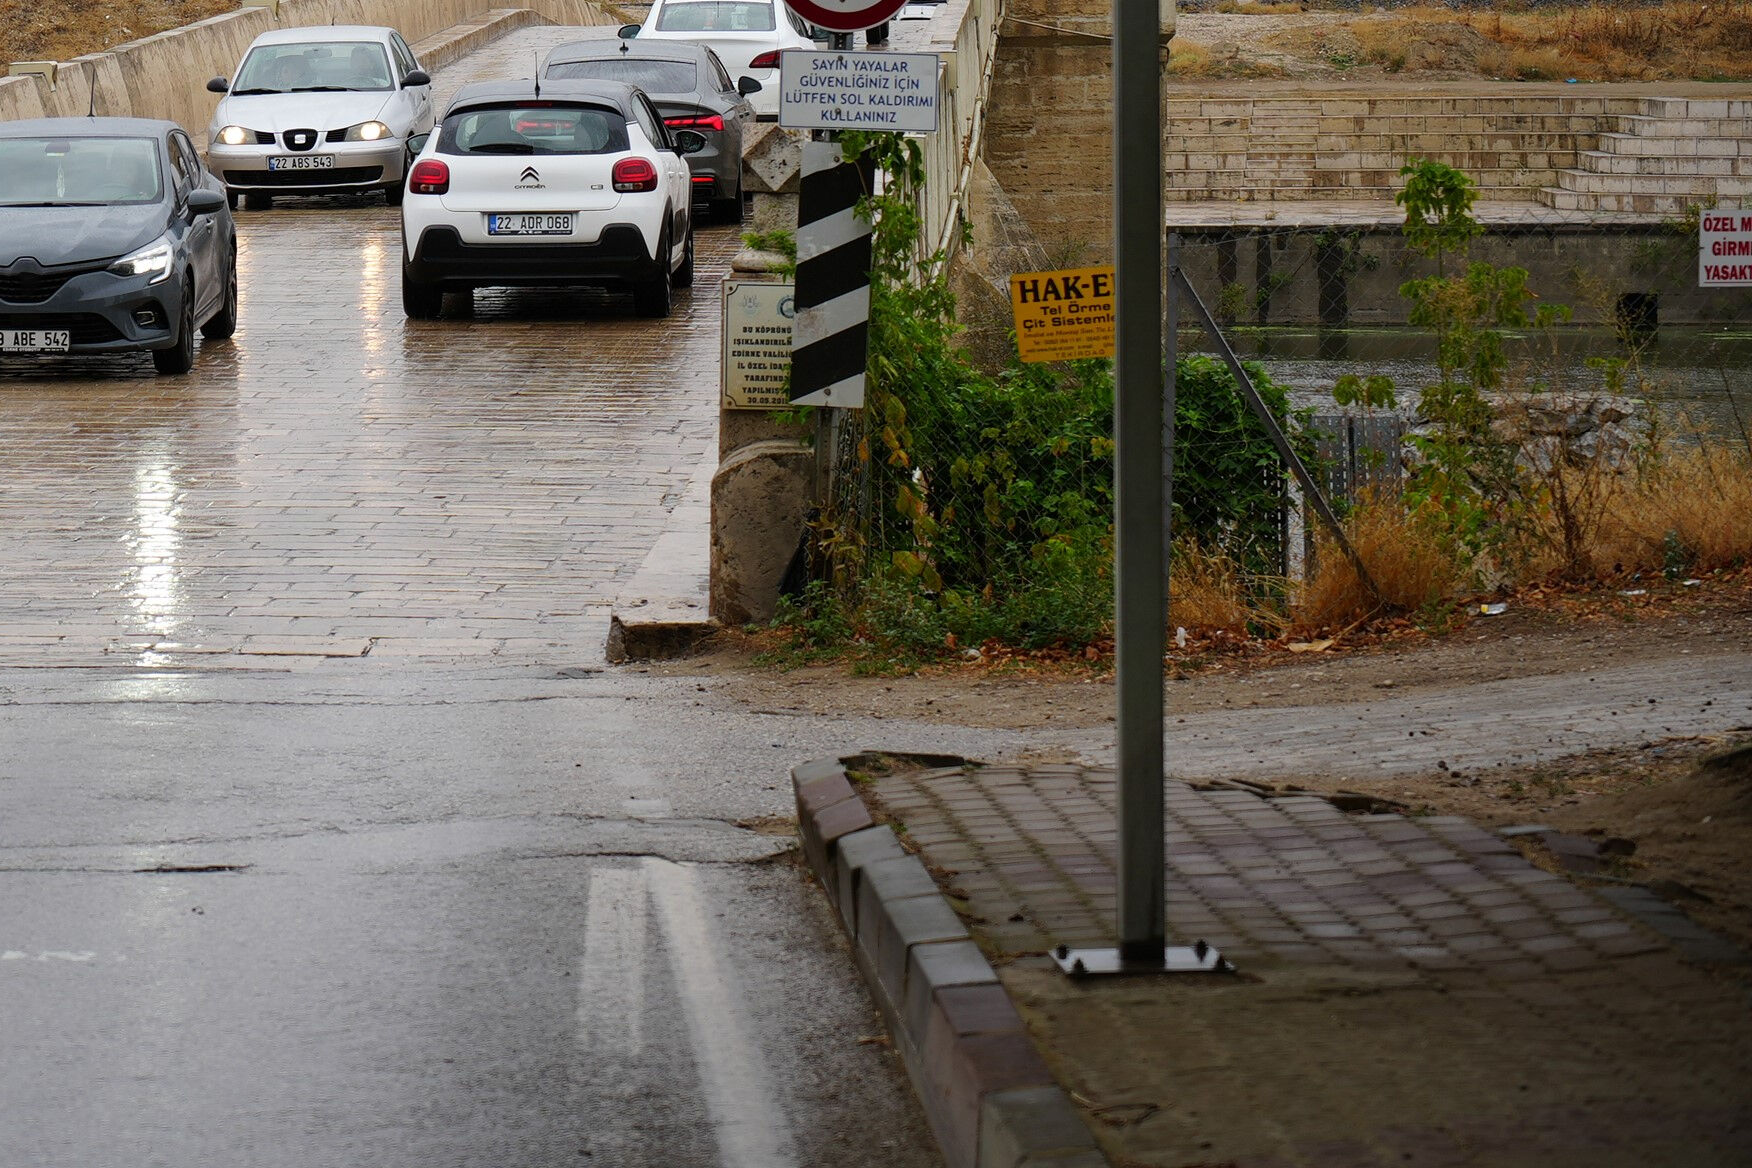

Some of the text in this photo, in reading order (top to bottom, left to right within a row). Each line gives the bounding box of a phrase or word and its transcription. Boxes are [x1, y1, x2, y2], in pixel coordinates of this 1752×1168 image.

[812, 59, 908, 73] SAYIN YAYALAR
[800, 73, 920, 92] GÜVENLİĞİNİZ İÇİN
[785, 89, 933, 107] LÜTFEN SOL KALDIRIMI
[821, 110, 897, 123] KULLANINIZ
[275, 159, 287, 168] 22
[313, 157, 332, 168] 543
[497, 216, 570, 229] 22 ADR 068
[1703, 213, 1737, 232] ÖZEL
[1712, 237, 1752, 256] GİRM
[1018, 273, 1115, 303] HAK-E
[1040, 301, 1111, 316] Tel Örme
[1023, 318, 1046, 332] Çit
[13, 332, 36, 346] ABE
[44, 332, 68, 346] 542
[747, 362, 767, 370] ÖZEL
